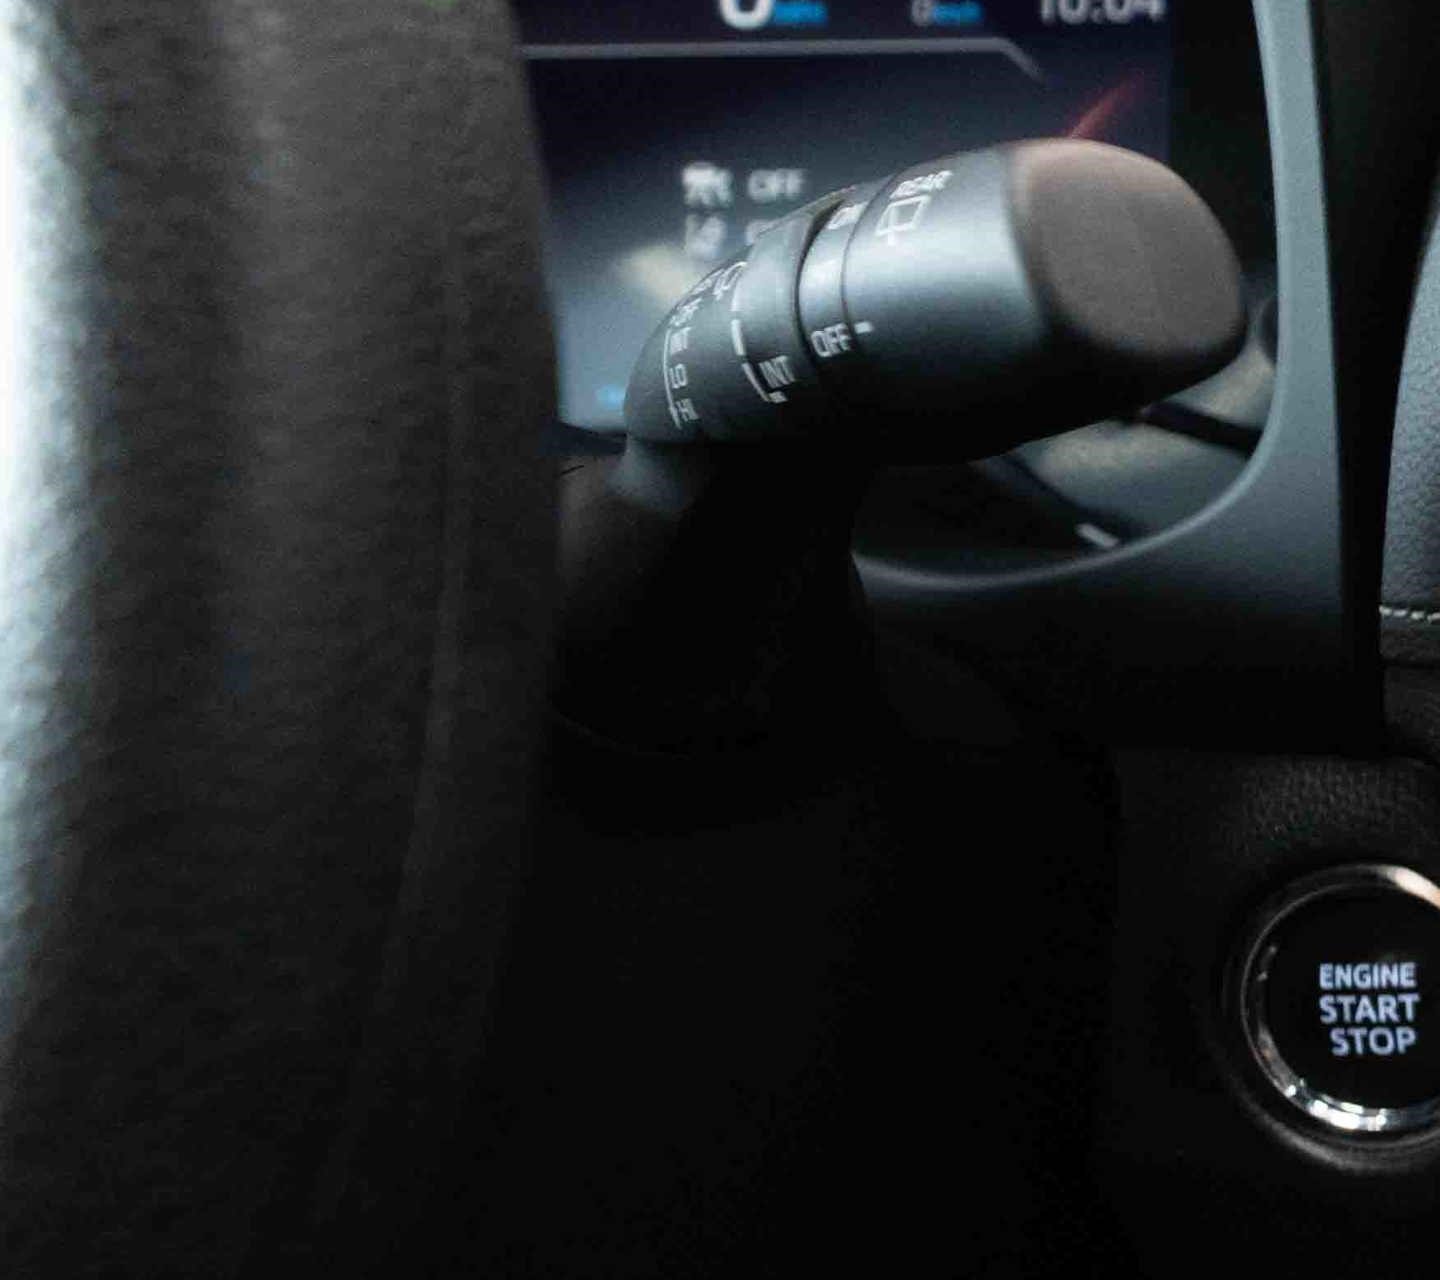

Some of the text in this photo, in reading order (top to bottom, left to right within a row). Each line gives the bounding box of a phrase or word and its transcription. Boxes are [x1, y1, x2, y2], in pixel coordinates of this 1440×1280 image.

[747, 168, 806, 202] OFF
[810, 322, 852, 358] OFF
[758, 355, 797, 387] INT
[1319, 962, 1417, 990] ENGINE
[1319, 993, 1420, 1024] START
[1330, 1026, 1417, 1057] STOP
